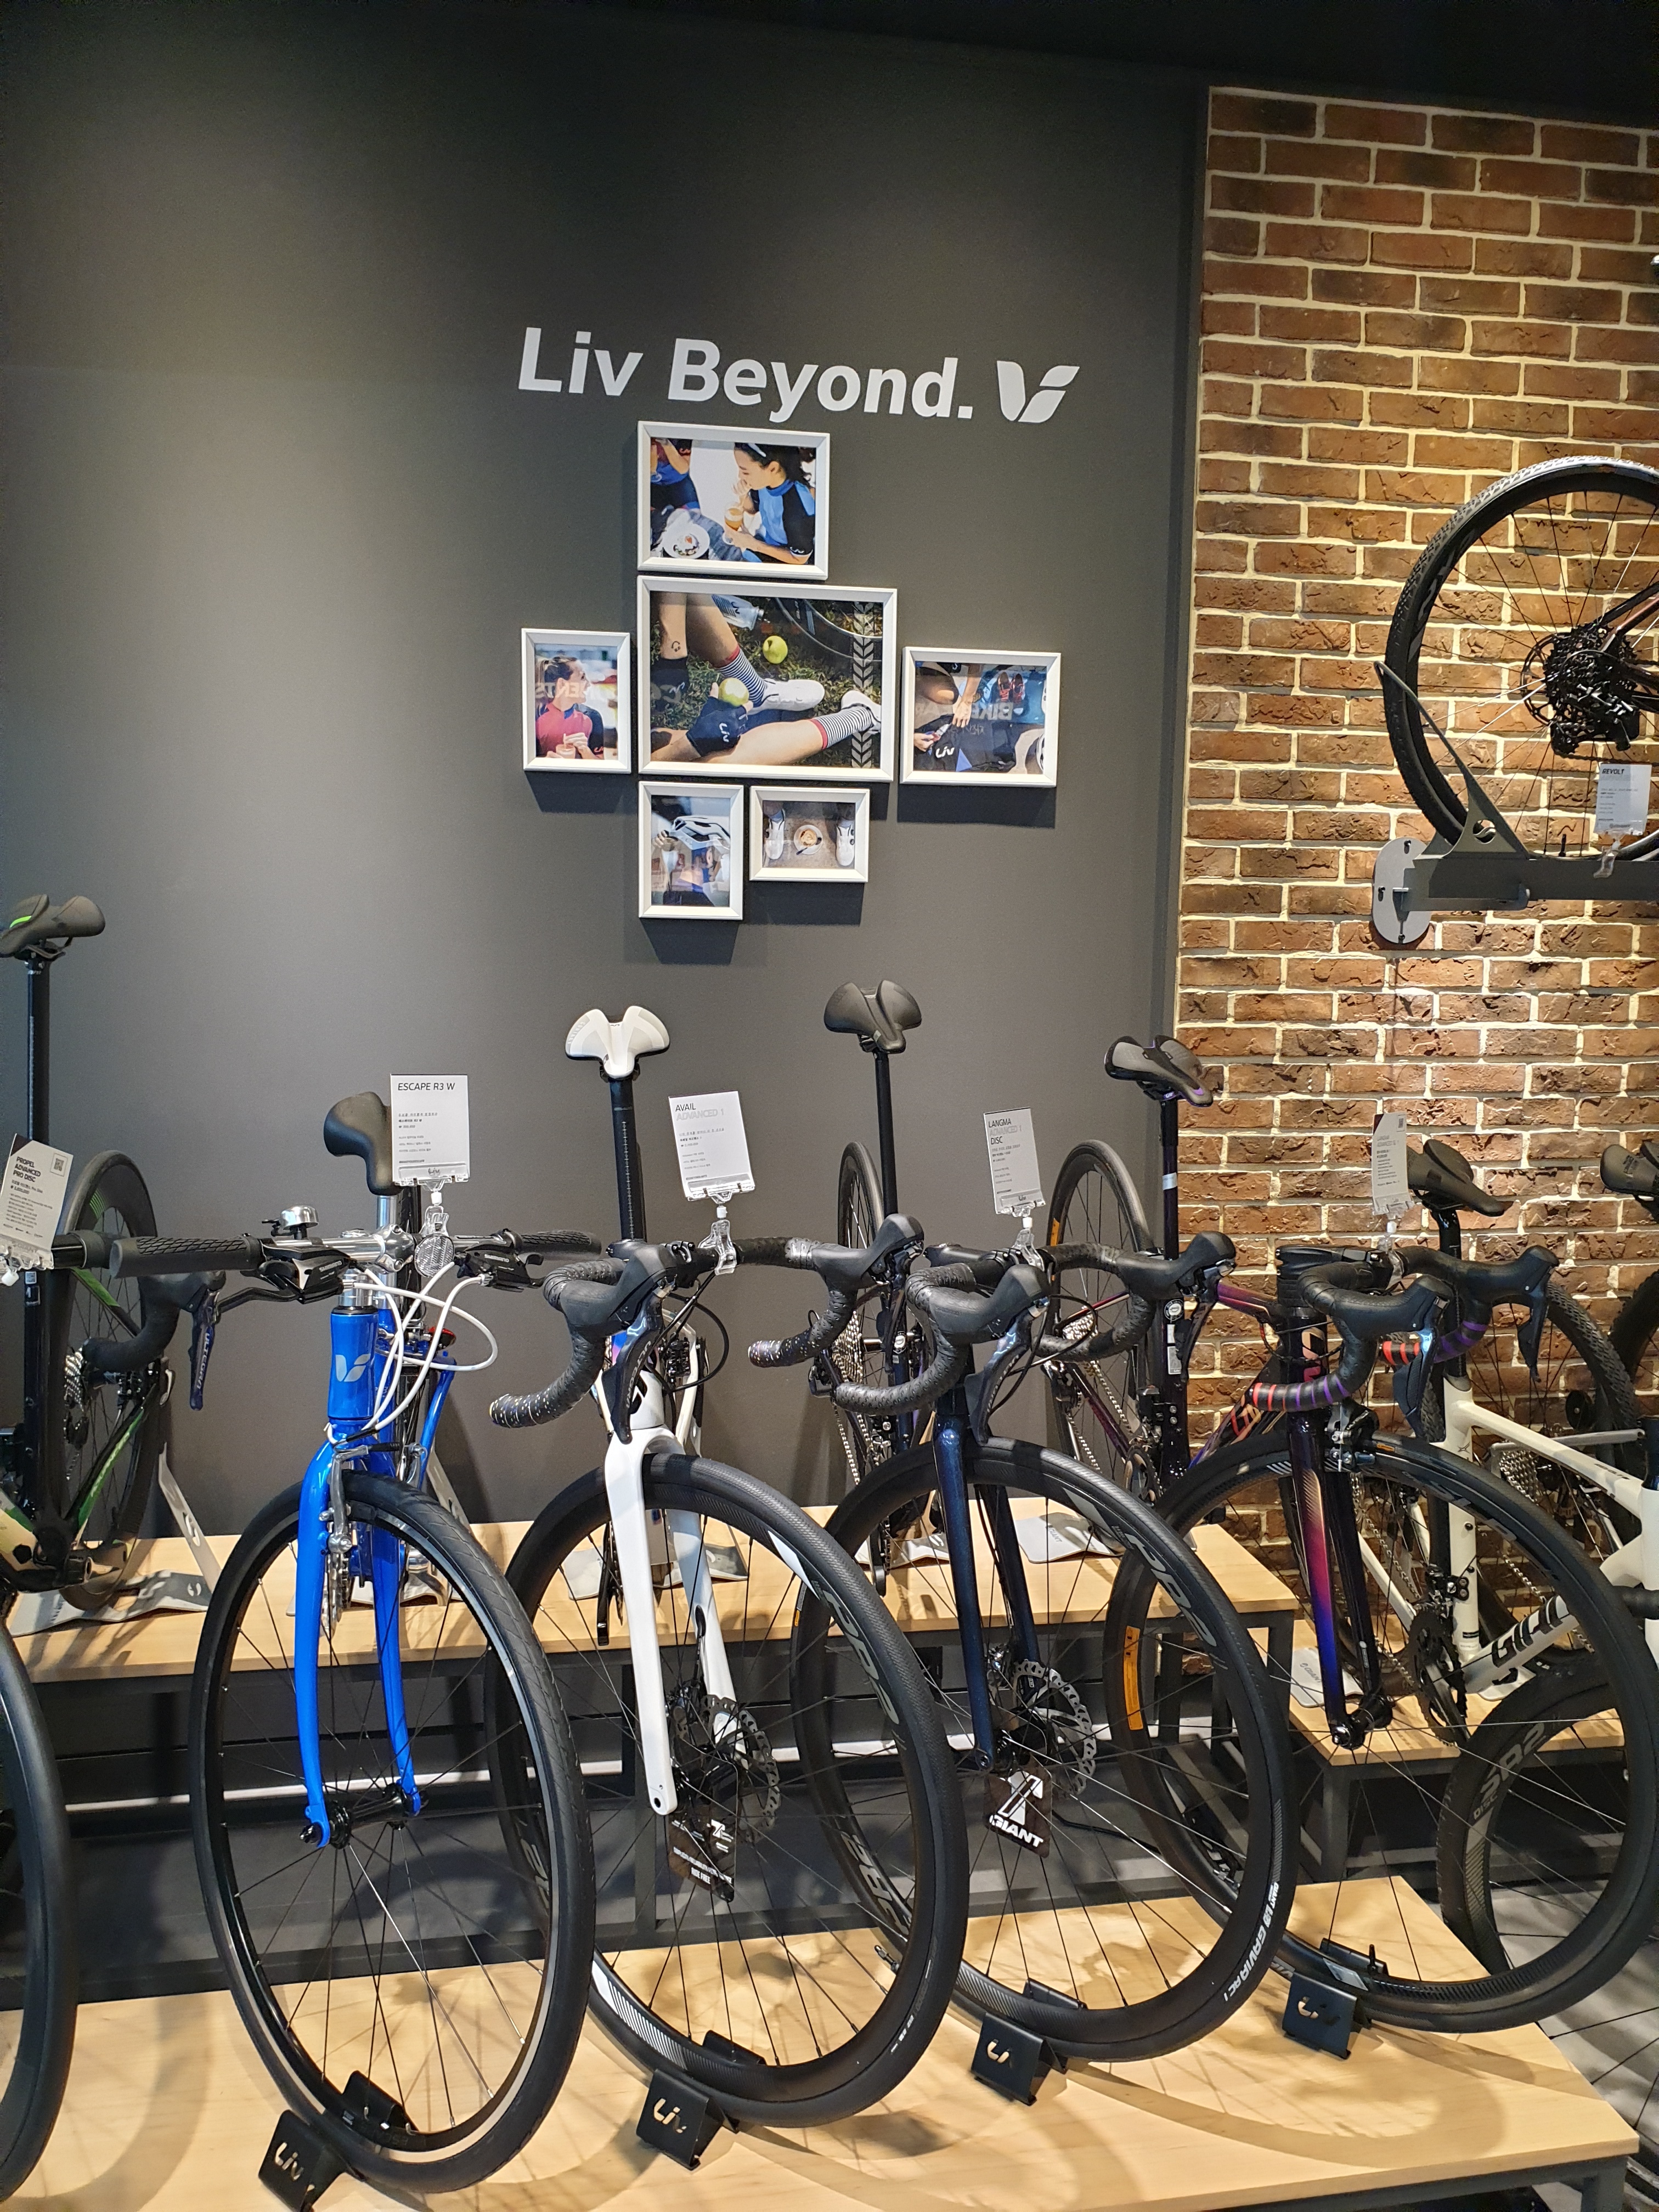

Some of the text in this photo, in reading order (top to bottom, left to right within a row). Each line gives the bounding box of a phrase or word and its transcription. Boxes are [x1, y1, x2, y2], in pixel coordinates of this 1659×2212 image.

[518, 326, 974, 423] Liv Beyond.
[935, 746, 955, 759] Liv
[398, 1082, 455, 1091] ESCAPE R3 W
[675, 1103, 696, 1112] AVAIL
[676, 1109, 718, 1121] ADVANCED
[988, 1118, 1012, 1128] LANGMA
[990, 1136, 1003, 1145] DISC
[16, 1156, 35, 1168] PROPEL
[13, 1170, 36, 1183] PRO DISC
[15, 1164, 41, 1177] ADVANCED
[1472, 1793, 1498, 1820] DISC
[989, 1814, 1044, 1848] GIANT
[1269, 1882, 1279, 1909] GIANT
[1240, 1925, 1267, 1981] GAVIA
[653, 2097, 687, 2135] Liv
[274, 2141, 304, 2182] Liv
